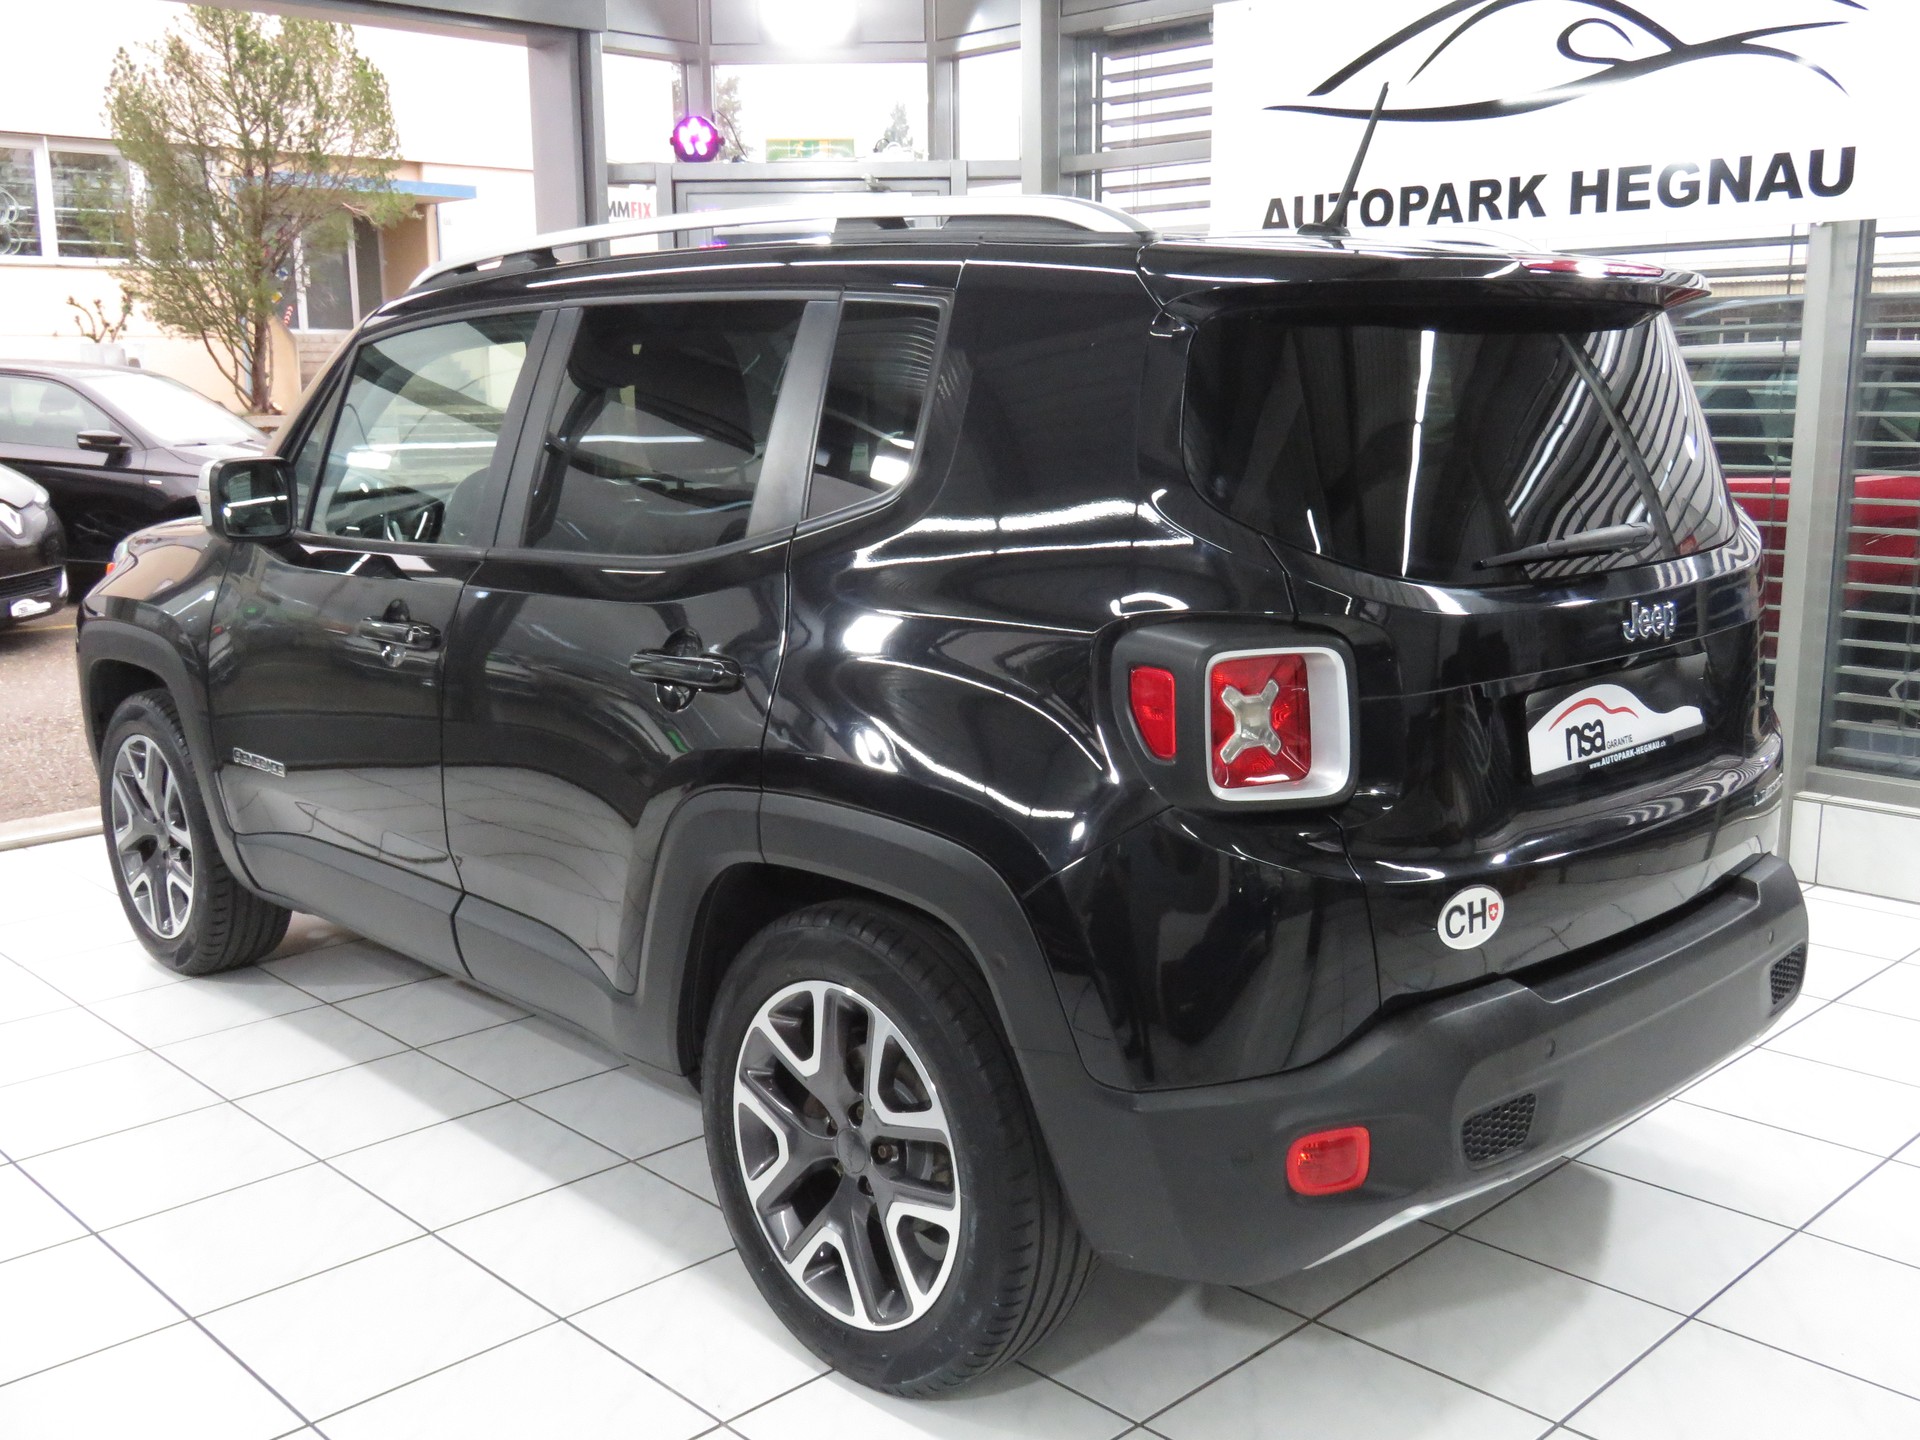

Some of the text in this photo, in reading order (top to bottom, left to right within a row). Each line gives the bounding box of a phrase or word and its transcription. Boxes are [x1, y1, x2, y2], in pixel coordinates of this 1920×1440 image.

[1261, 145, 1857, 230] AUTOPARK HEGNAU
[1622, 600, 1676, 641] Jeep
[1565, 718, 1633, 761] nsa GARANTIE
[1588, 740, 1667, 770] www.AUTOPARK-HEGNAU.ch
[1444, 896, 1488, 939] CH
